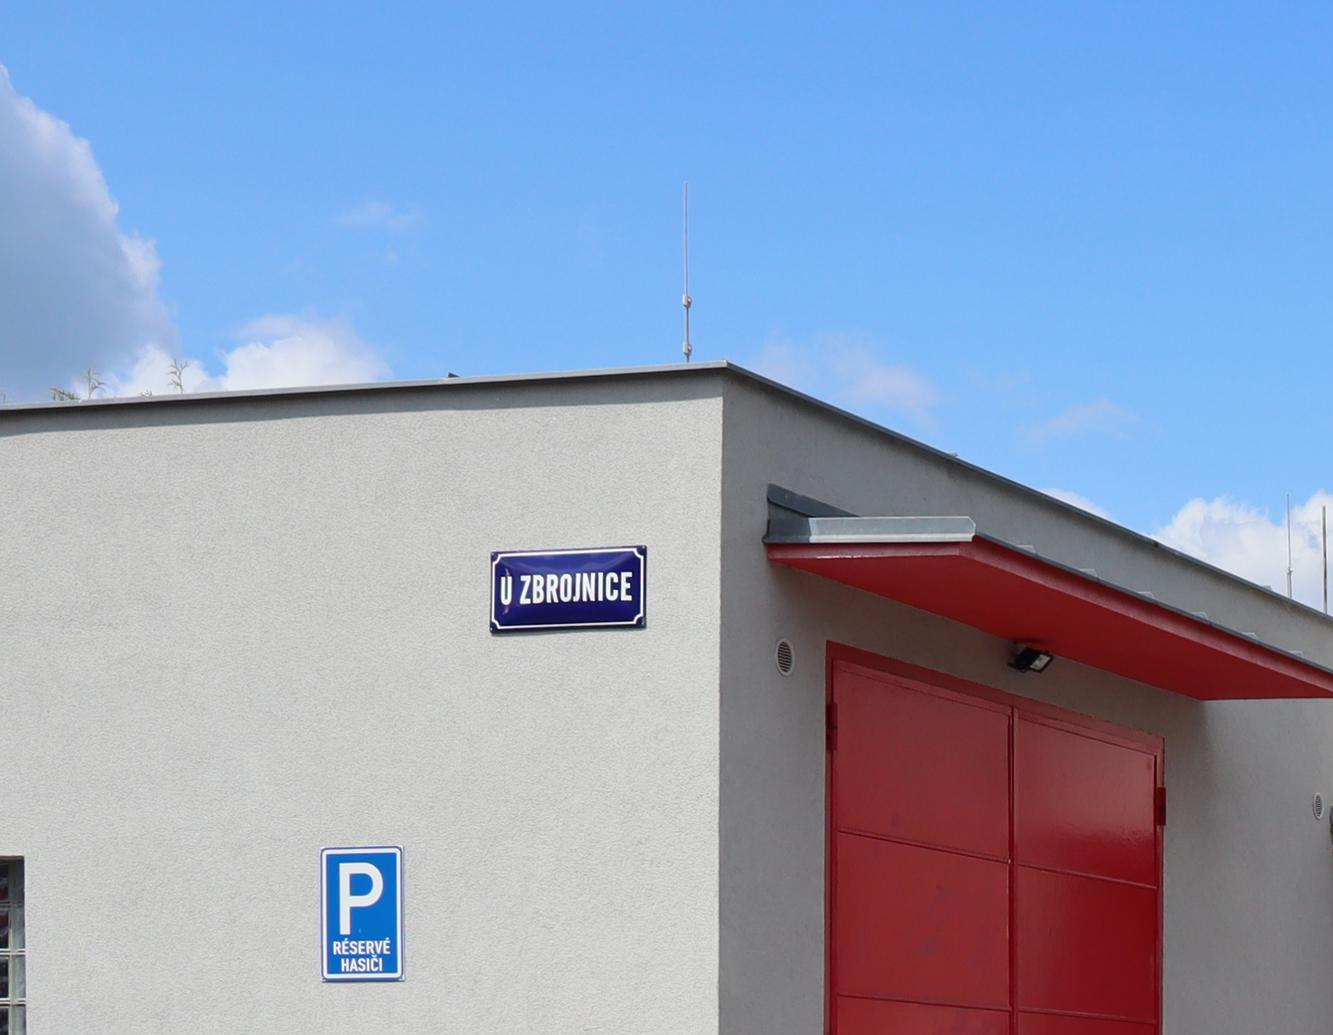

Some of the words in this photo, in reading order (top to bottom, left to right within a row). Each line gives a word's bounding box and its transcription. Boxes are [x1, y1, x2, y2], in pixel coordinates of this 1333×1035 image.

[500, 575, 513, 606] U
[519, 571, 633, 605] ZBROJNICE
[338, 862, 384, 935] P
[332, 937, 392, 955] RÉSERVÉ
[340, 954, 383, 972] HASIČI
